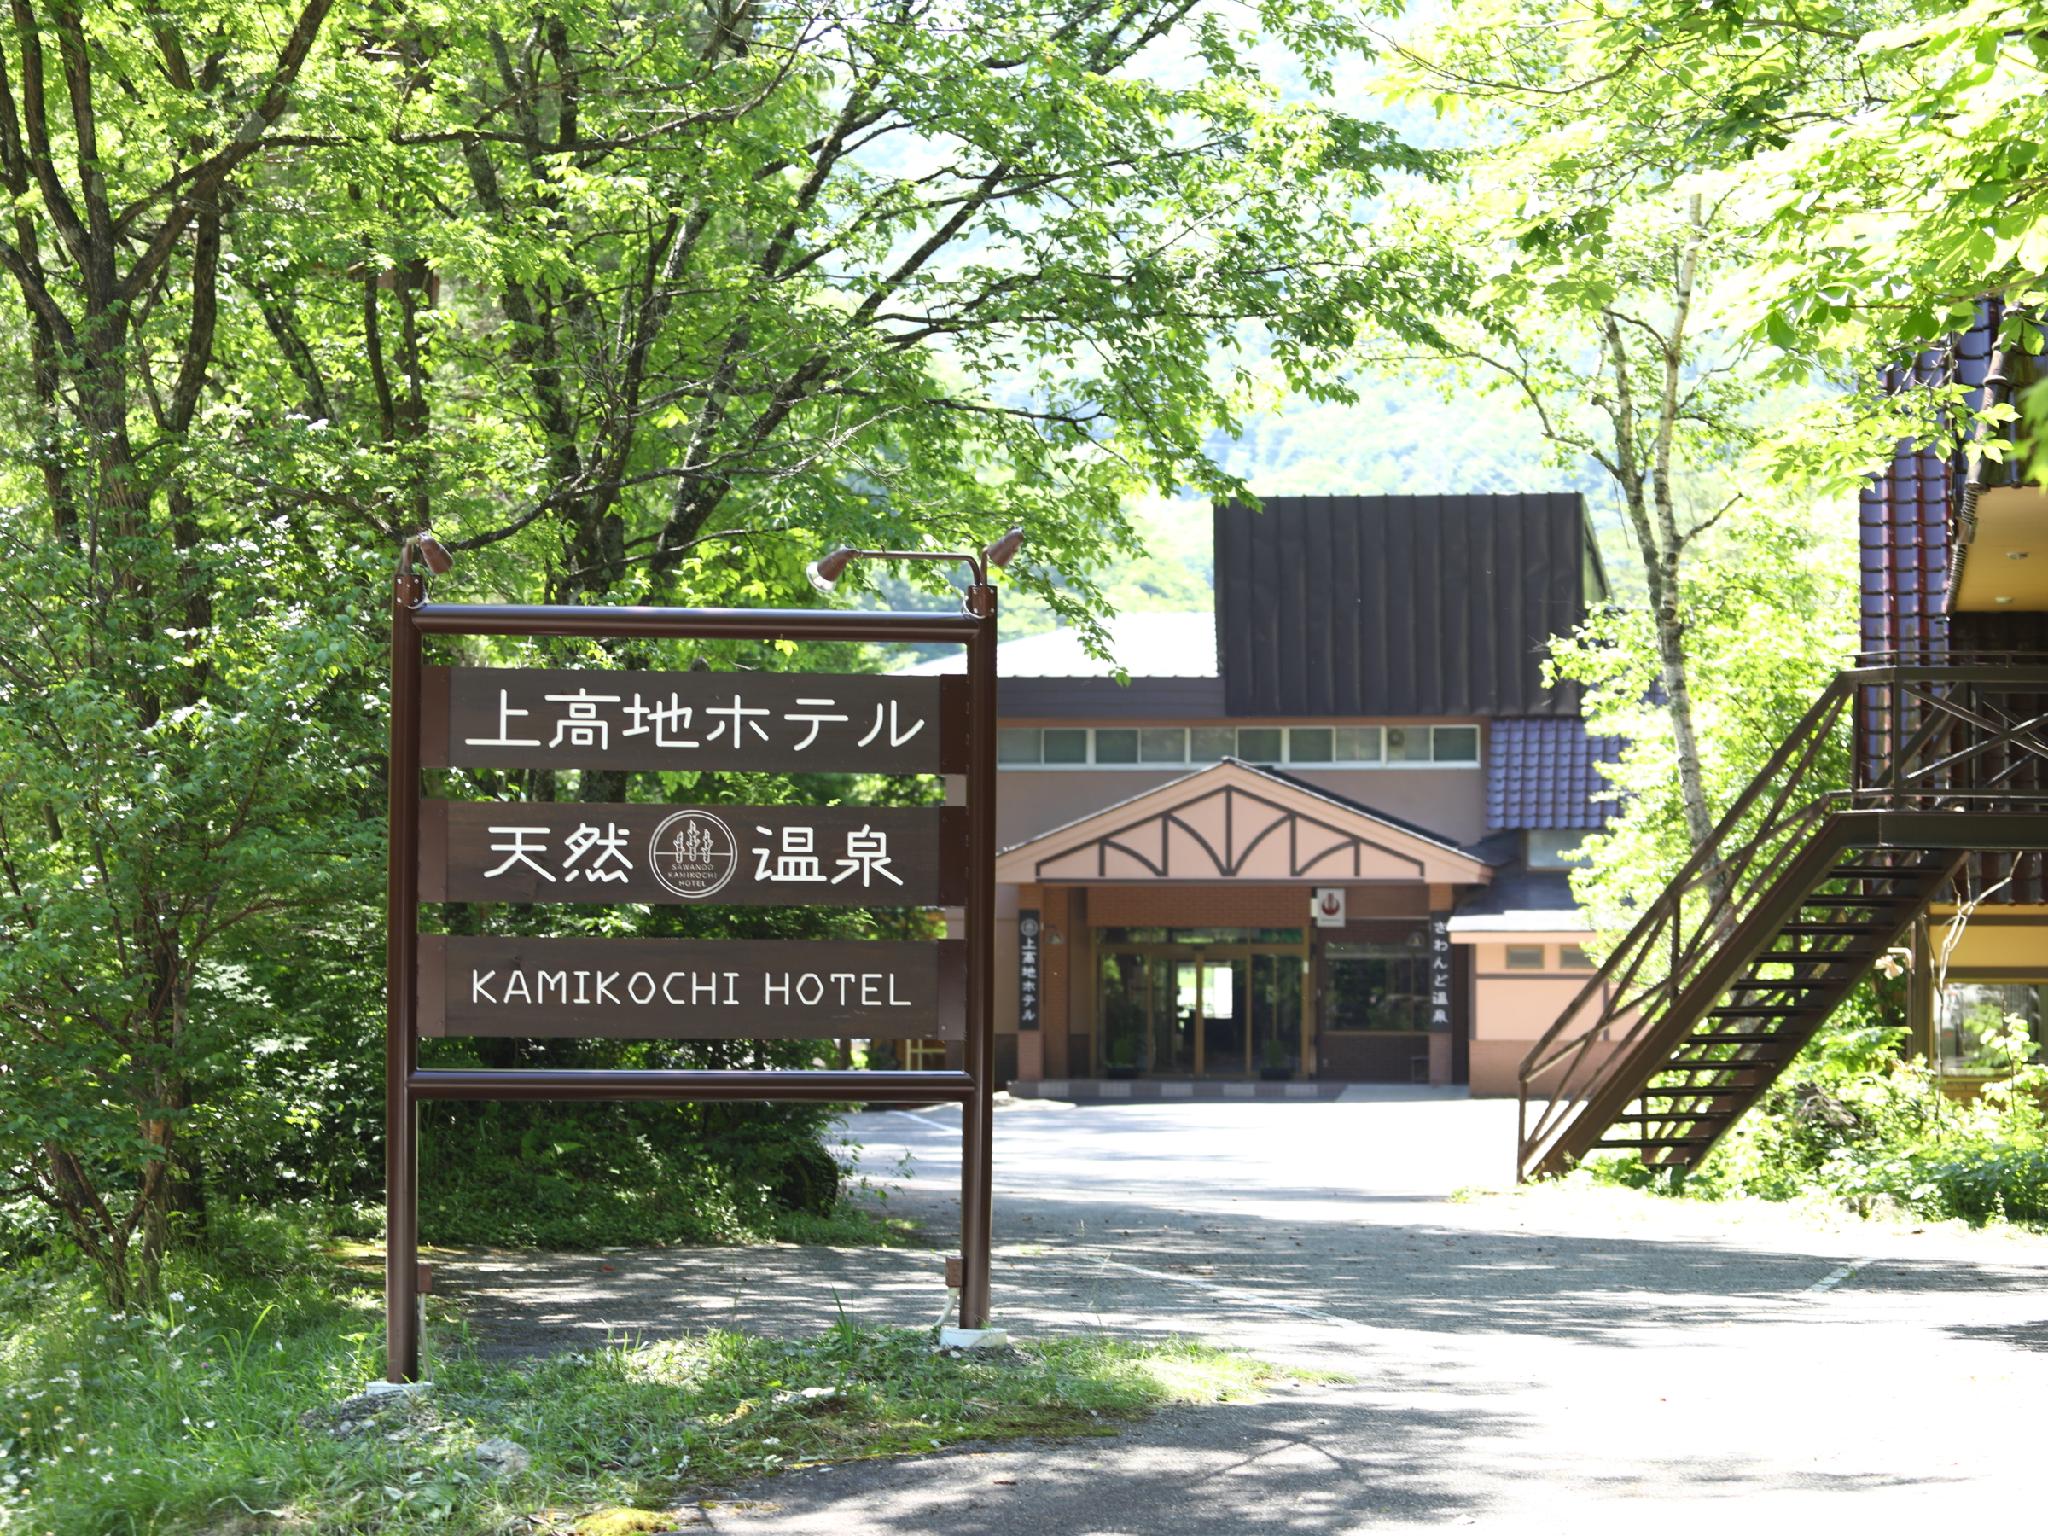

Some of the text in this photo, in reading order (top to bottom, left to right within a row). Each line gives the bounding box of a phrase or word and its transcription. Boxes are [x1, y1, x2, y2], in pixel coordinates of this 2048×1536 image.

[465, 687, 925, 752] 上高地ホテル
[484, 822, 904, 888] 天然 温泉
[667, 871, 718, 879] KAMIKOCHI
[671, 863, 714, 871] SAWANDO
[471, 968, 912, 1007] KAMIKOCHI HOTEL
[1021, 937, 1037, 1021] 上高地ホテル
[1432, 921, 1449, 1023] さわんど温泉
